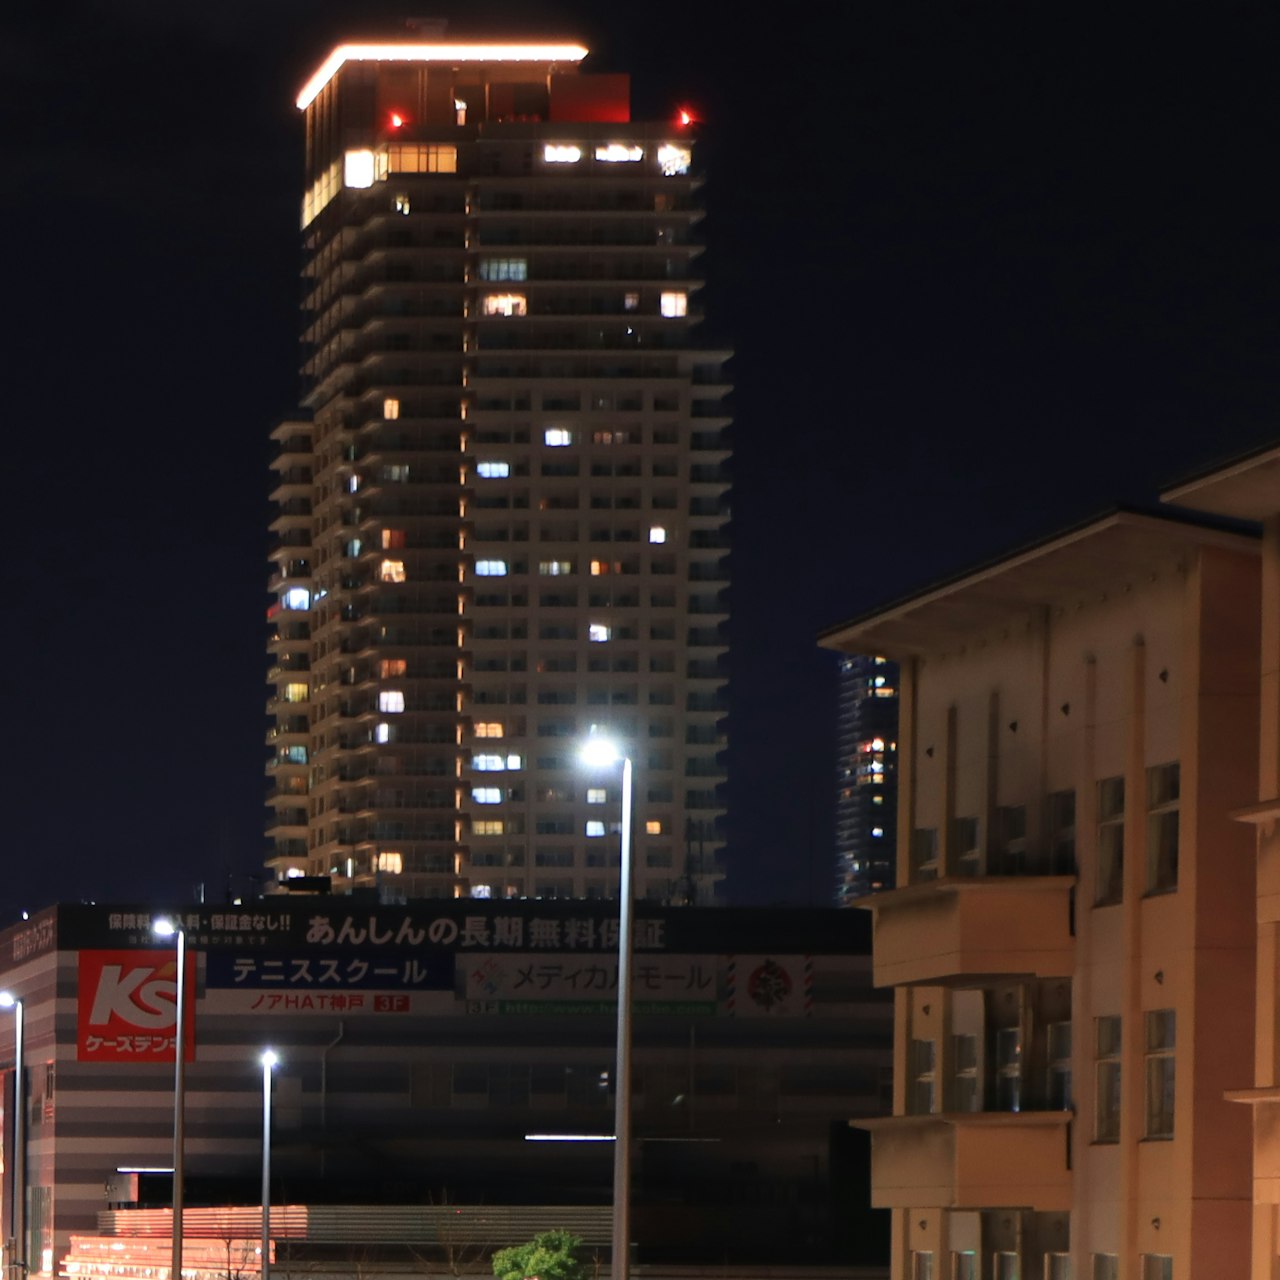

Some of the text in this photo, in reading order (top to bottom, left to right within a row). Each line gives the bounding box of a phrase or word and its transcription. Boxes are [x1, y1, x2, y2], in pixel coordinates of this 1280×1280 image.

[306, 916, 665, 948] あんしんの長期無料保証
[234, 958, 427, 982] テニススクール
[251, 994, 405, 1011] ノアHAT神戸 3F
